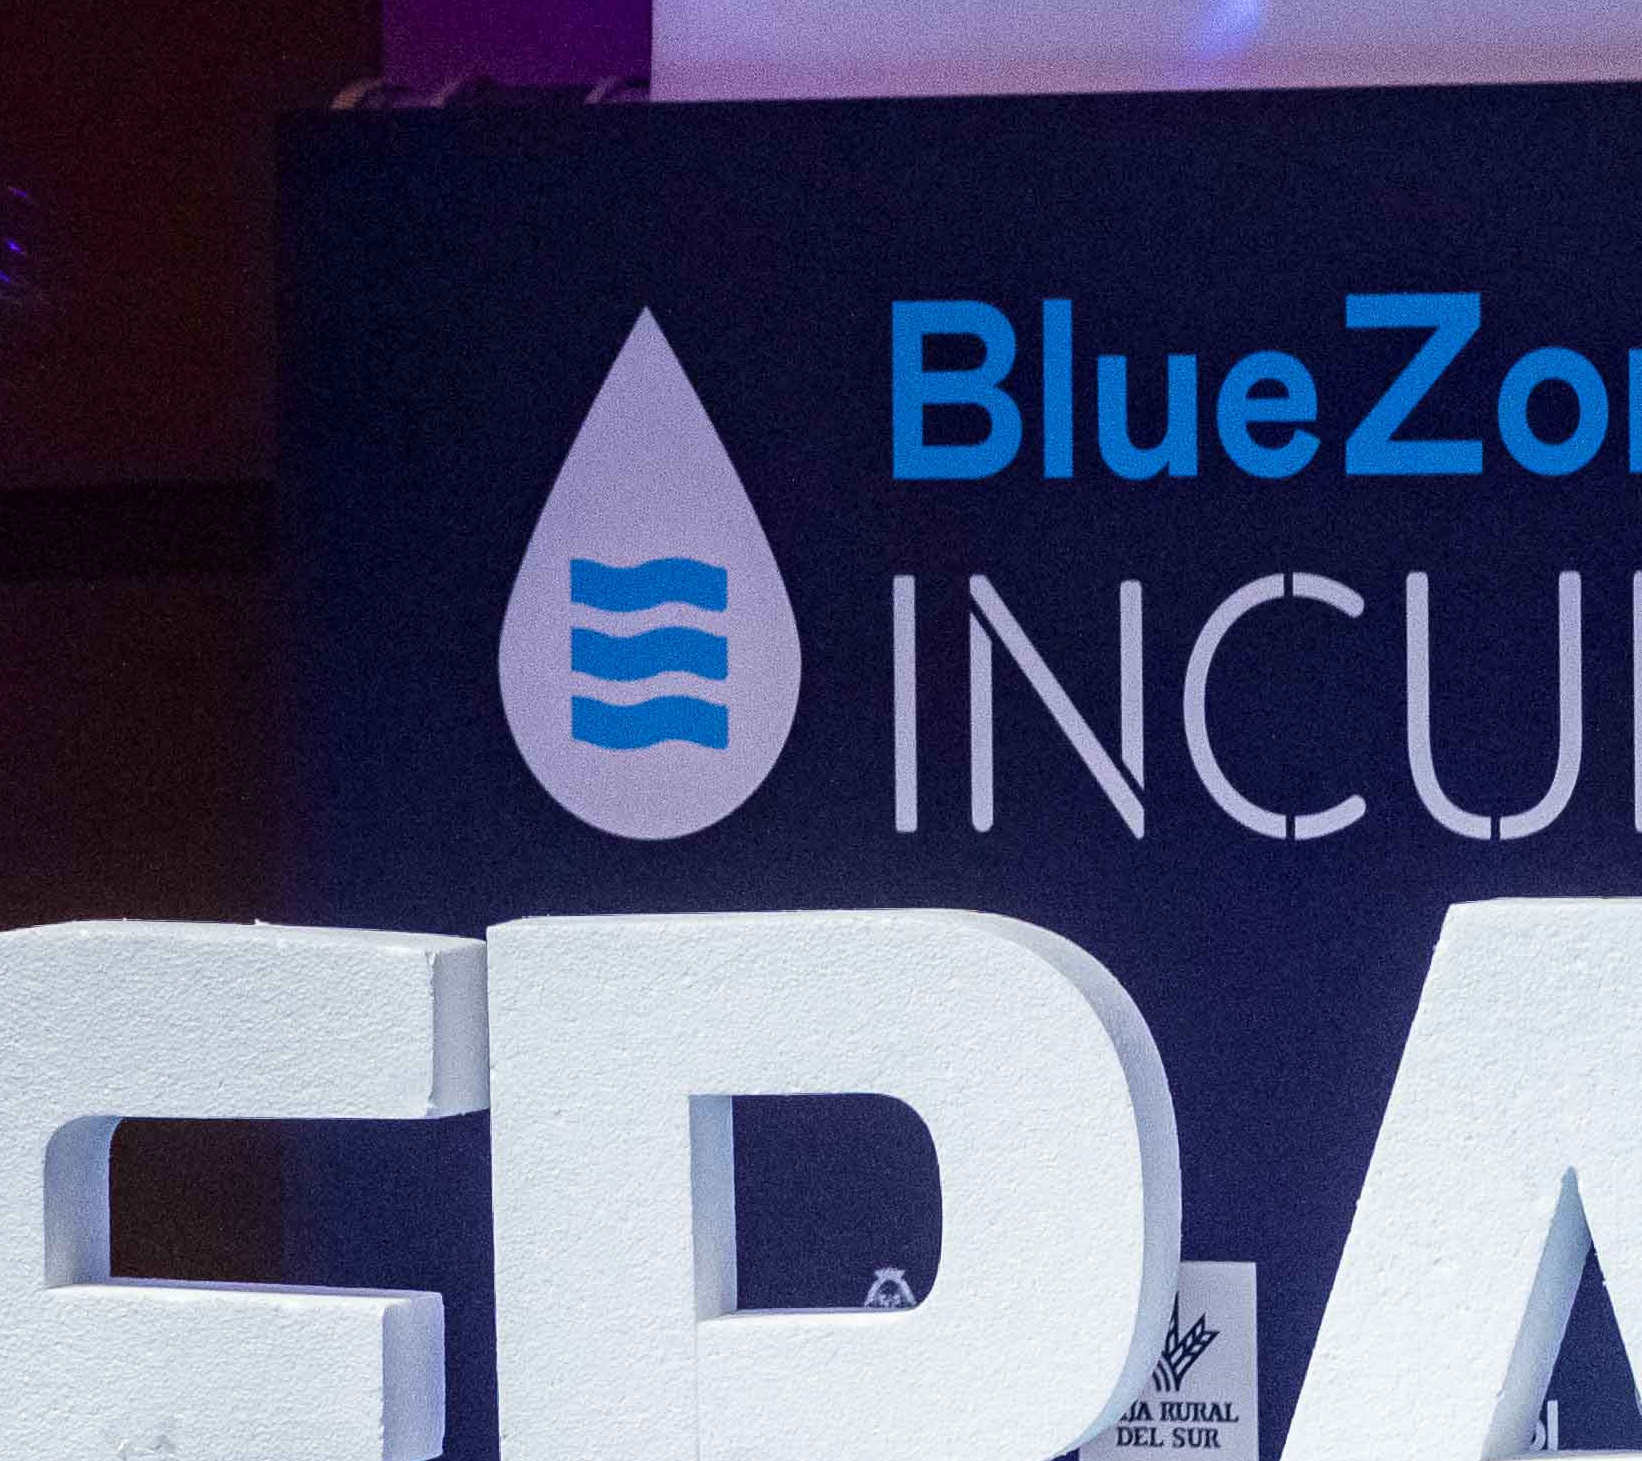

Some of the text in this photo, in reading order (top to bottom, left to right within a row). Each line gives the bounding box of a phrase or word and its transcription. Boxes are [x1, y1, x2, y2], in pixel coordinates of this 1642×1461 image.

[1160, 1400, 1240, 1423] RURAL
[1115, 1425, 1222, 1449] DEL SUR
